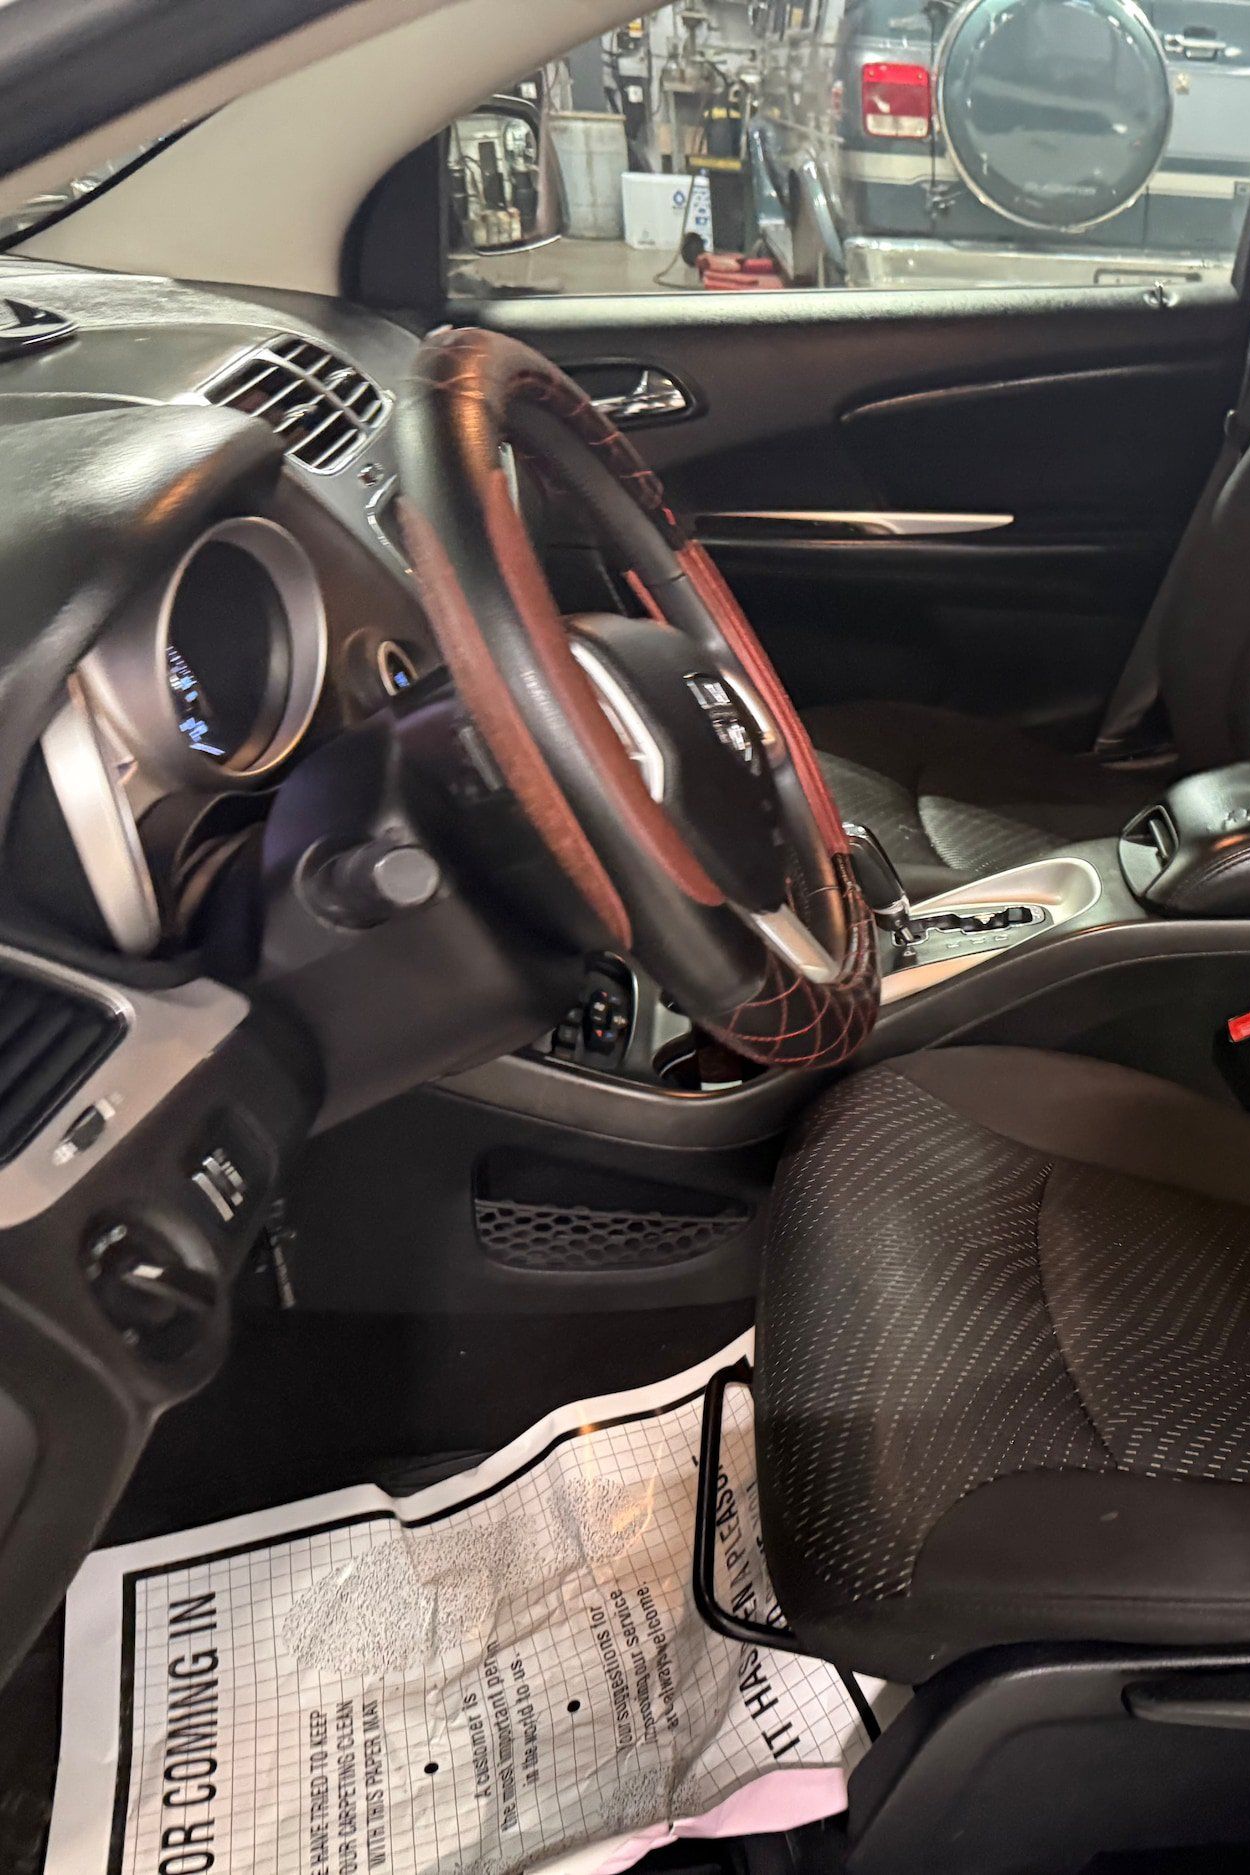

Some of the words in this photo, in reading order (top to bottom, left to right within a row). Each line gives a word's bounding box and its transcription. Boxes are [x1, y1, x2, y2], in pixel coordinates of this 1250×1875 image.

[730, 1561, 750, 1589] A
[168, 1591, 218, 1639] IN
[590, 1605, 607, 1630] for
[610, 1588, 639, 1648] service
[510, 1652, 527, 1682] us.
[597, 1629, 629, 1722] suggestions
[631, 1651, 647, 1677] our
[462, 1692, 477, 1713] is
[516, 1684, 532, 1705] to
[739, 1648, 779, 1720] HAS
[163, 1648, 219, 1808] COMING
[310, 1709, 327, 1747] KEEP
[336, 1699, 354, 1750] CLEAN
[363, 1699, 380, 1733] MAT
[487, 1693, 514, 1767] important
[517, 1703, 538, 1745] world
[469, 1713, 490, 1787] customer
[522, 1743, 540, 1770] the
[762, 1722, 800, 1759] IT
[310, 1751, 328, 1774] TO
[364, 1735, 383, 1787] PAPER
[523, 1769, 541, 1787] in
[310, 1775, 329, 1823] TRIED
[337, 1752, 357, 1838] CARPETING
[475, 1784, 492, 1799] A
[499, 1763, 516, 1802] most
[366, 1789, 385, 1826] THIS
[501, 1801, 519, 1833] the
[310, 1822, 329, 1867] HAVE
[367, 1824, 386, 1871] WITH
